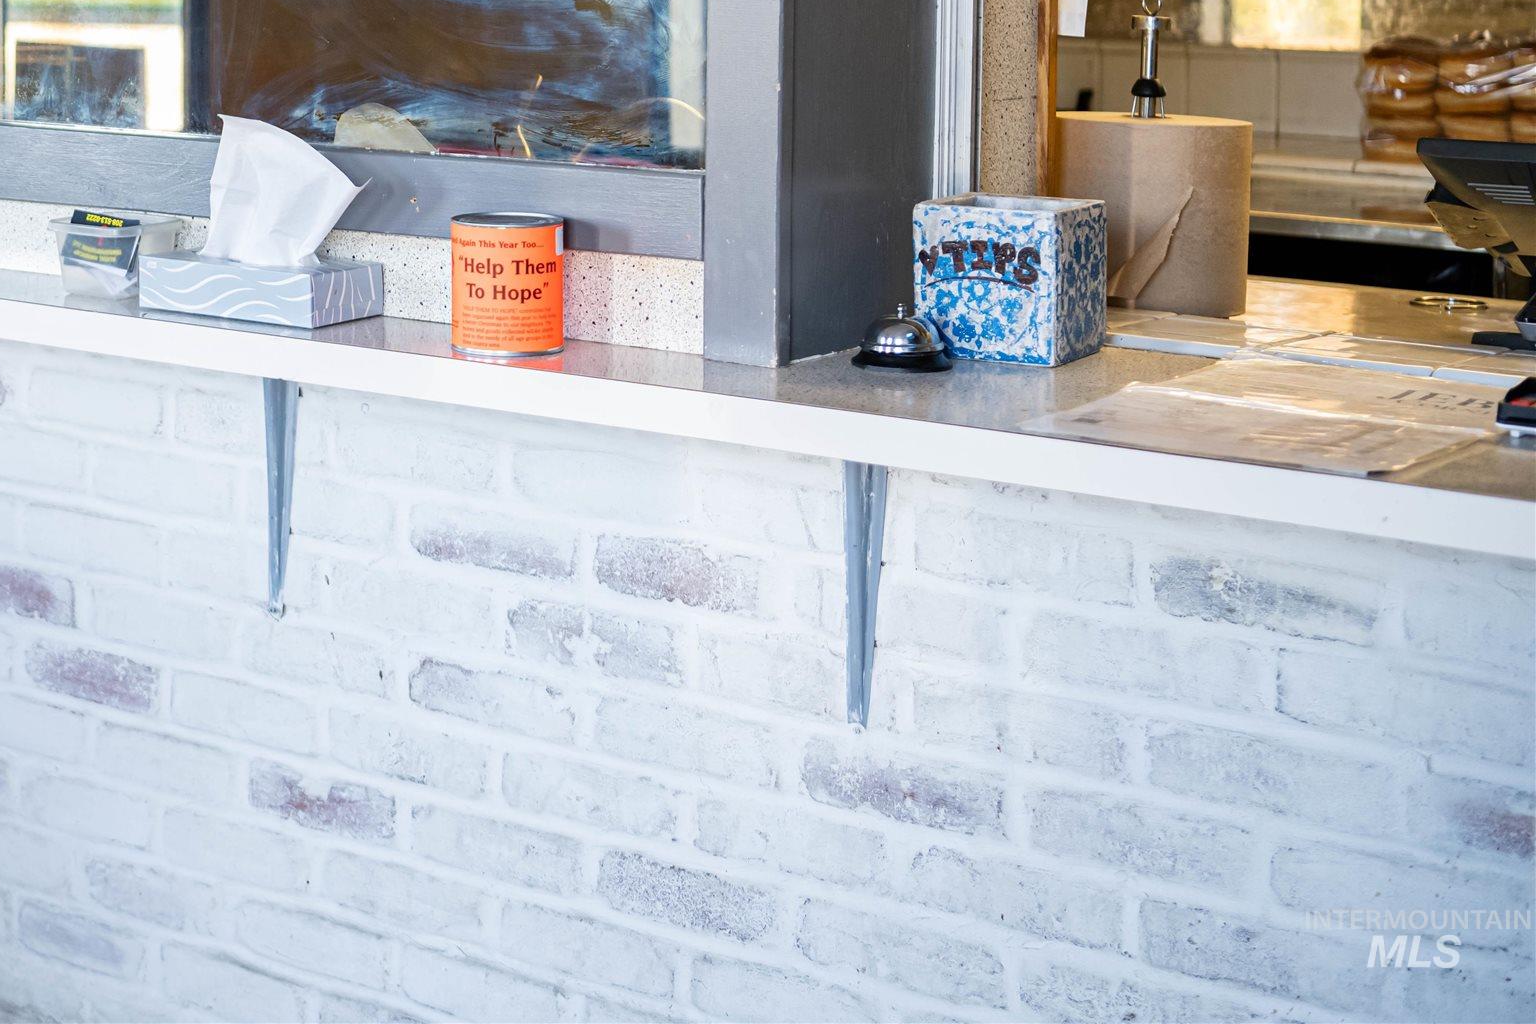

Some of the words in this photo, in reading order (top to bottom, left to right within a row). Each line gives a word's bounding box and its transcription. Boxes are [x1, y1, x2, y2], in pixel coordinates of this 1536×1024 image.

[459, 238, 477, 247] Again
[478, 239, 496, 248] This
[498, 239, 518, 249] Year
[458, 255, 504, 278] "Help
[511, 258, 557, 275] Them
[942, 240, 1041, 284] TIPS
[466, 282, 485, 299] To
[492, 281, 549, 304] Hope"
